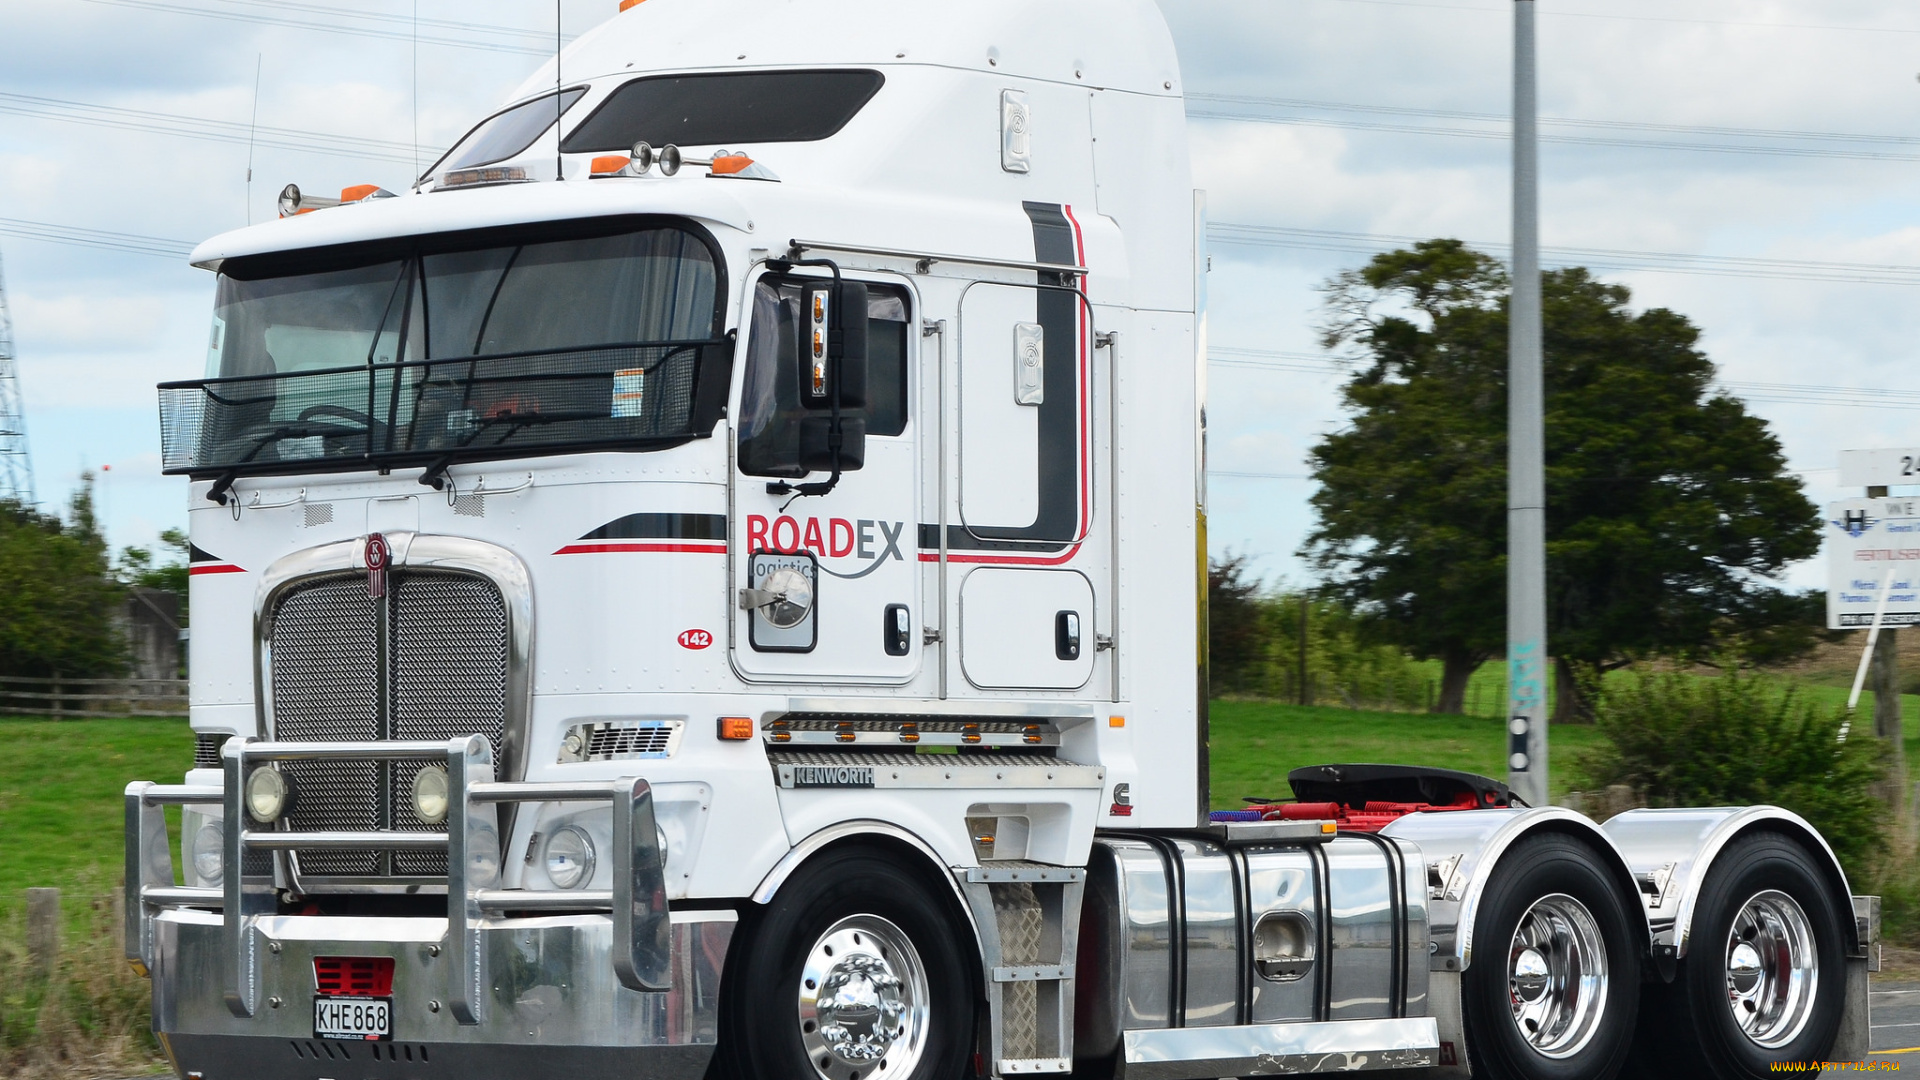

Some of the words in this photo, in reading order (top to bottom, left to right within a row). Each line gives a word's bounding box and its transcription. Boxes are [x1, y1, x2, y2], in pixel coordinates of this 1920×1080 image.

[747, 514, 904, 560] ROADEX
[749, 557, 817, 579] Logitics
[681, 632, 709, 646] 142
[796, 767, 875, 784] KENWORTH
[318, 1004, 386, 1031] KHE868
